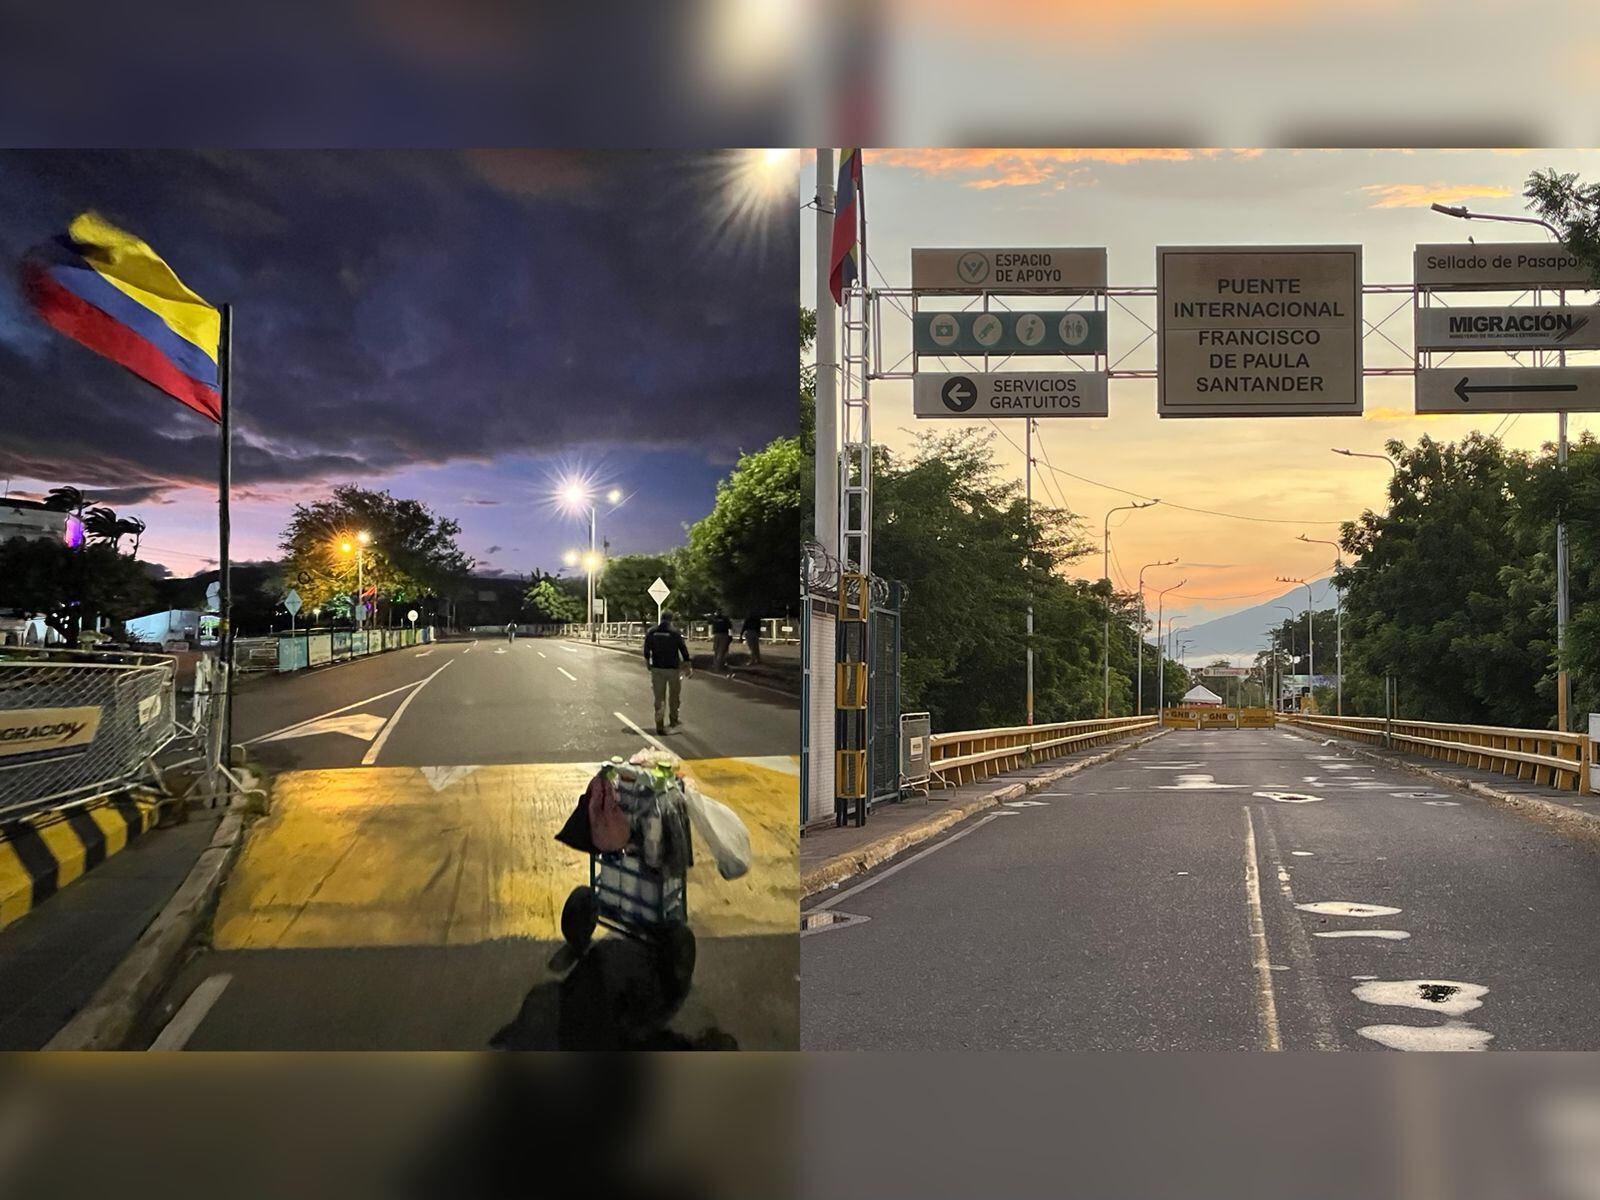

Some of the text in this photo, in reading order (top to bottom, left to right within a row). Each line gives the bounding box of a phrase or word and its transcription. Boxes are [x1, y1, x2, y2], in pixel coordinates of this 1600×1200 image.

[995, 254, 1052, 267] ESPACIO
[1427, 255, 1578, 271] Sellado de Pasapo
[995, 269, 1062, 282] DE APOYO
[1217, 278, 1301, 294] PUENTE
[1174, 301, 1345, 318] INTERNACIONAL
[1449, 311, 1572, 333] MIGRACIÓN
[1198, 329, 1321, 346] FRANCISCO
[1209, 352, 1310, 369] DE PAULA
[993, 379, 1077, 392] SERVICIOS
[1196, 376, 1324, 392] SANTANDER
[990, 395, 1081, 409] GRATUITOS
